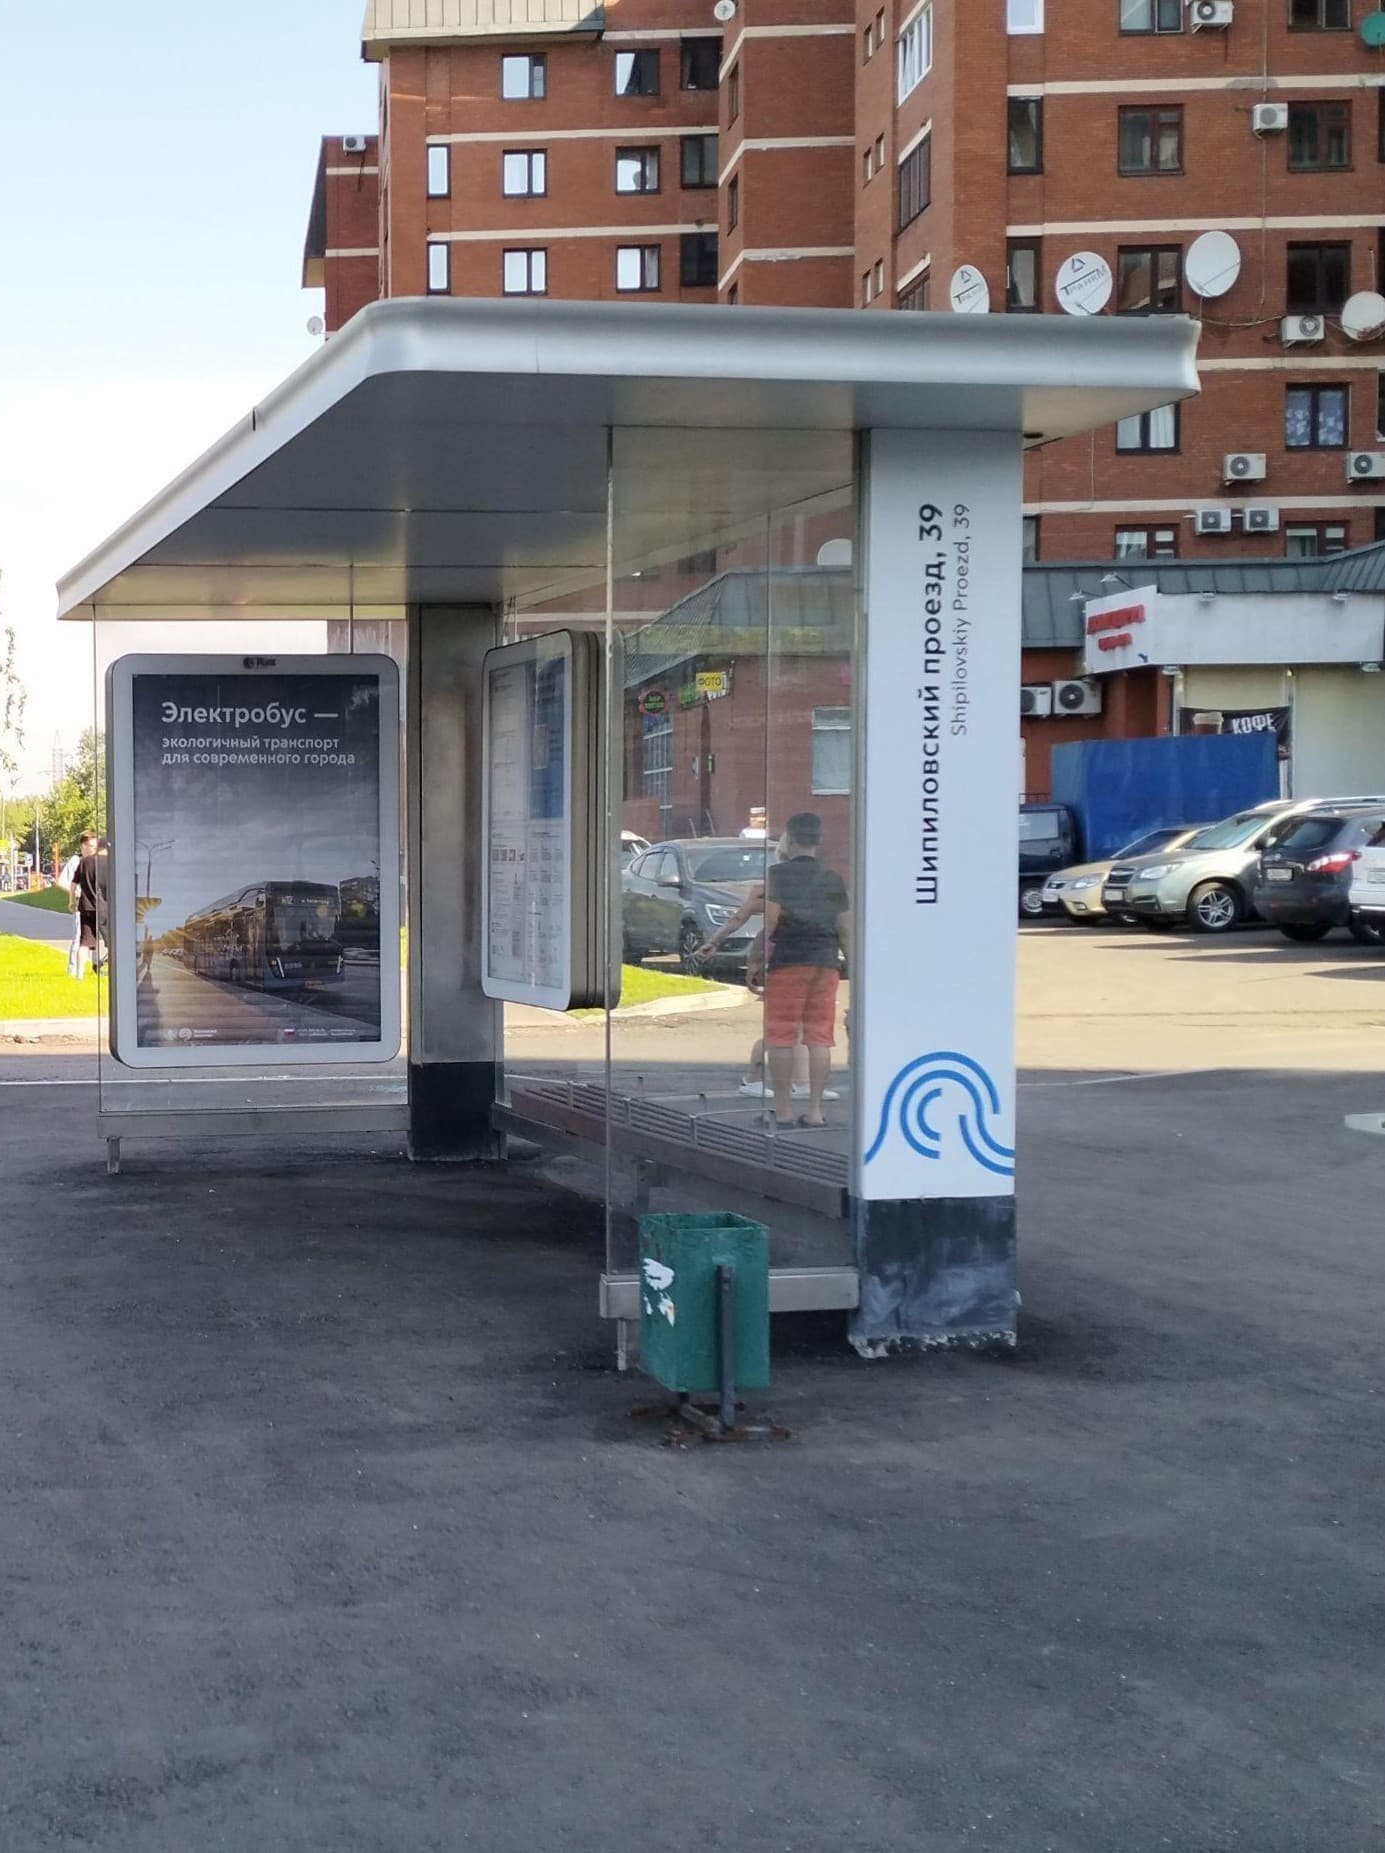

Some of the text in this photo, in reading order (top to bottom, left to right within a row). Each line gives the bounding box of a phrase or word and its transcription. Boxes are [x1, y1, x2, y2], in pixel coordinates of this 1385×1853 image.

[951, 504, 972, 736] Shipilovskiy Proezd, 39
[162, 702, 306, 728] Электробус
[915, 504, 948, 904] Шипиловский проезд, 39
[1232, 713, 1277, 734] КОФЕ
[162, 736, 339, 751] экологичный транспорт
[162, 753, 355, 766] для современного города
